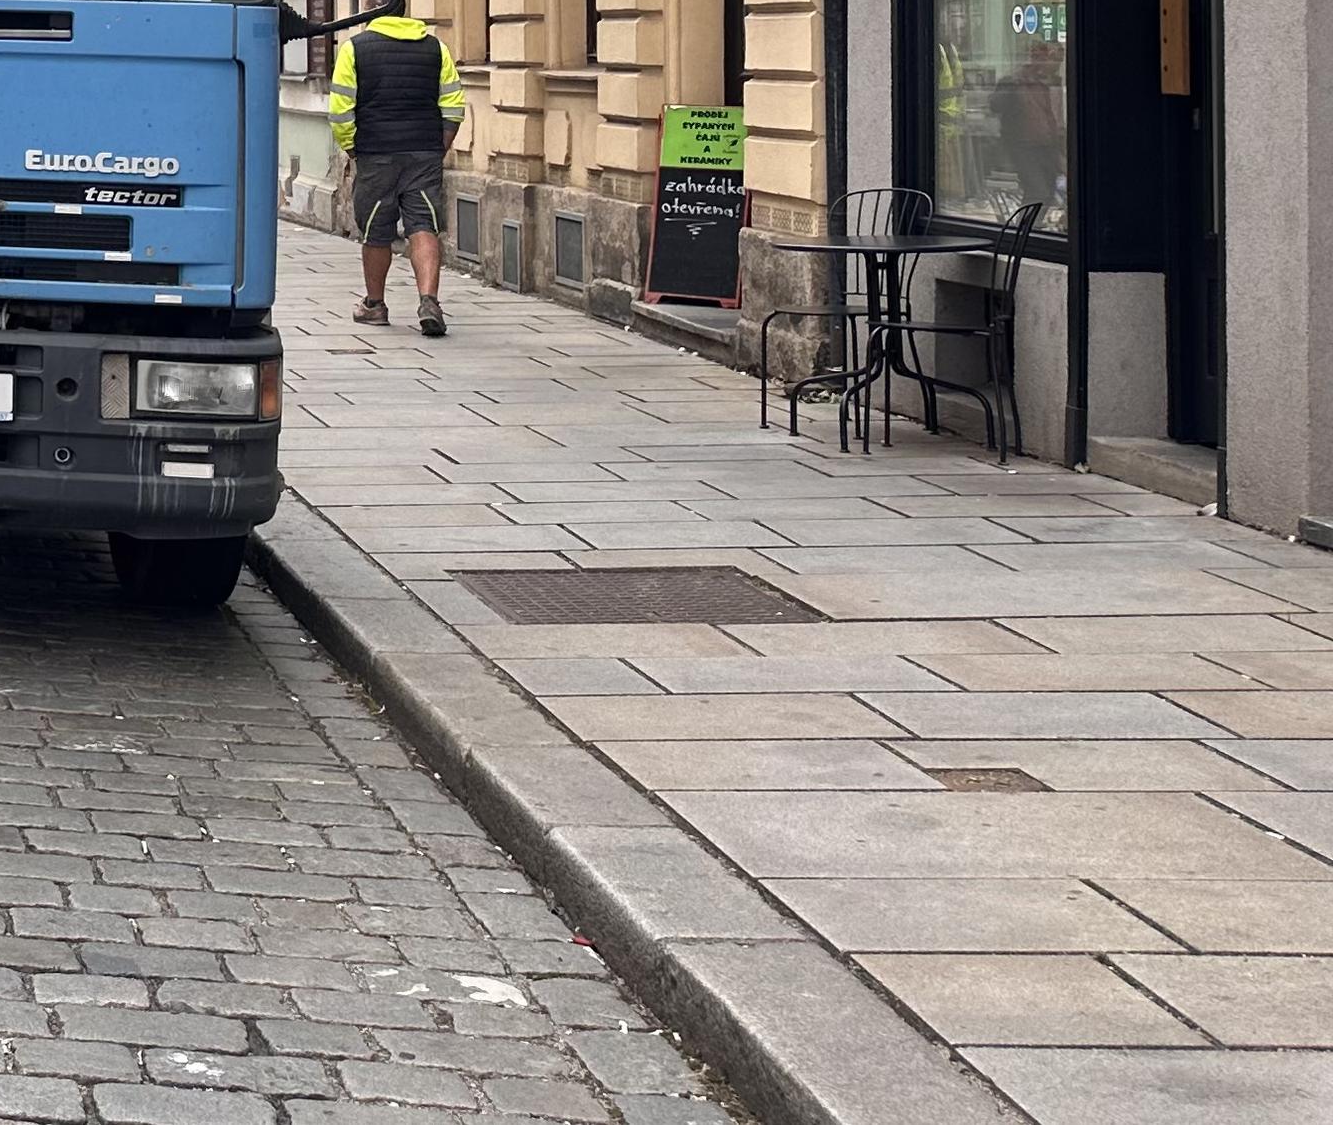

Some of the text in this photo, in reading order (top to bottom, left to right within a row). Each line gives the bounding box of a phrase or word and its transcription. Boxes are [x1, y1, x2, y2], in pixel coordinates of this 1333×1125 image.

[690, 111, 728, 119] PRODEJ
[703, 145, 711, 153] A
[24, 149, 181, 178] EuroCargo
[680, 156, 732, 165] KERAMIKY
[83, 186, 177, 206] tector
